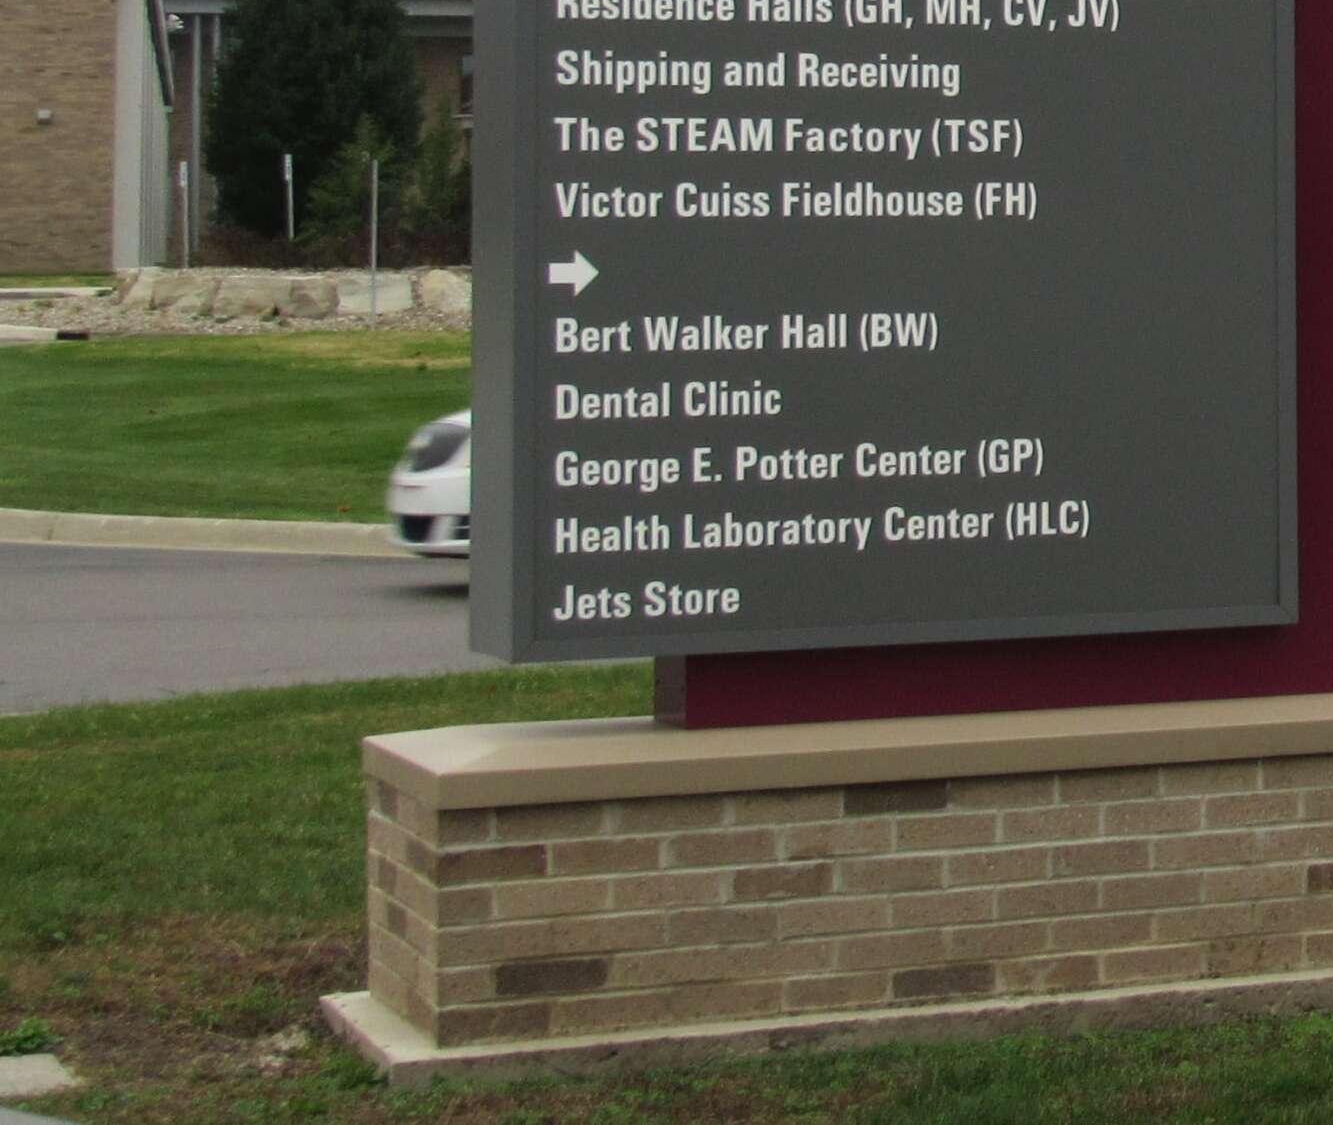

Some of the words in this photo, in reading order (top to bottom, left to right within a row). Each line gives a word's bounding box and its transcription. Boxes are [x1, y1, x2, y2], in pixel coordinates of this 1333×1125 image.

[555, 48, 712, 96] Shipping
[722, 51, 786, 88] and
[797, 51, 961, 98] Receiving
[553, 116, 626, 153] The
[635, 116, 774, 153] STEAM
[784, 117, 923, 161] Factory
[930, 117, 1024, 159] (TSF)
[554, 181, 664, 219] Victor
[674, 181, 771, 219] Cuiss
[782, 180, 964, 218] Fieldhouse
[973, 181, 1038, 221] (FH)
[554, 316, 633, 354] Bert
[642, 314, 770, 352] Walker
[781, 312, 848, 350] Hall
[859, 311, 939, 353] (BW)
[555, 381, 671, 421] Dental
[683, 379, 782, 418] Clinic
[554, 449, 681, 494] George
[692, 446, 723, 484] E.
[735, 445, 845, 482] Potter
[855, 441, 968, 478] Center
[977, 437, 1044, 479] (GP)
[554, 513, 671, 555] Health
[683, 511, 873, 552] Laboratory
[883, 505, 995, 542] Center
[1005, 499, 1090, 542] (HLC)
[552, 584, 632, 622] Jets
[643, 580, 741, 618] Store
